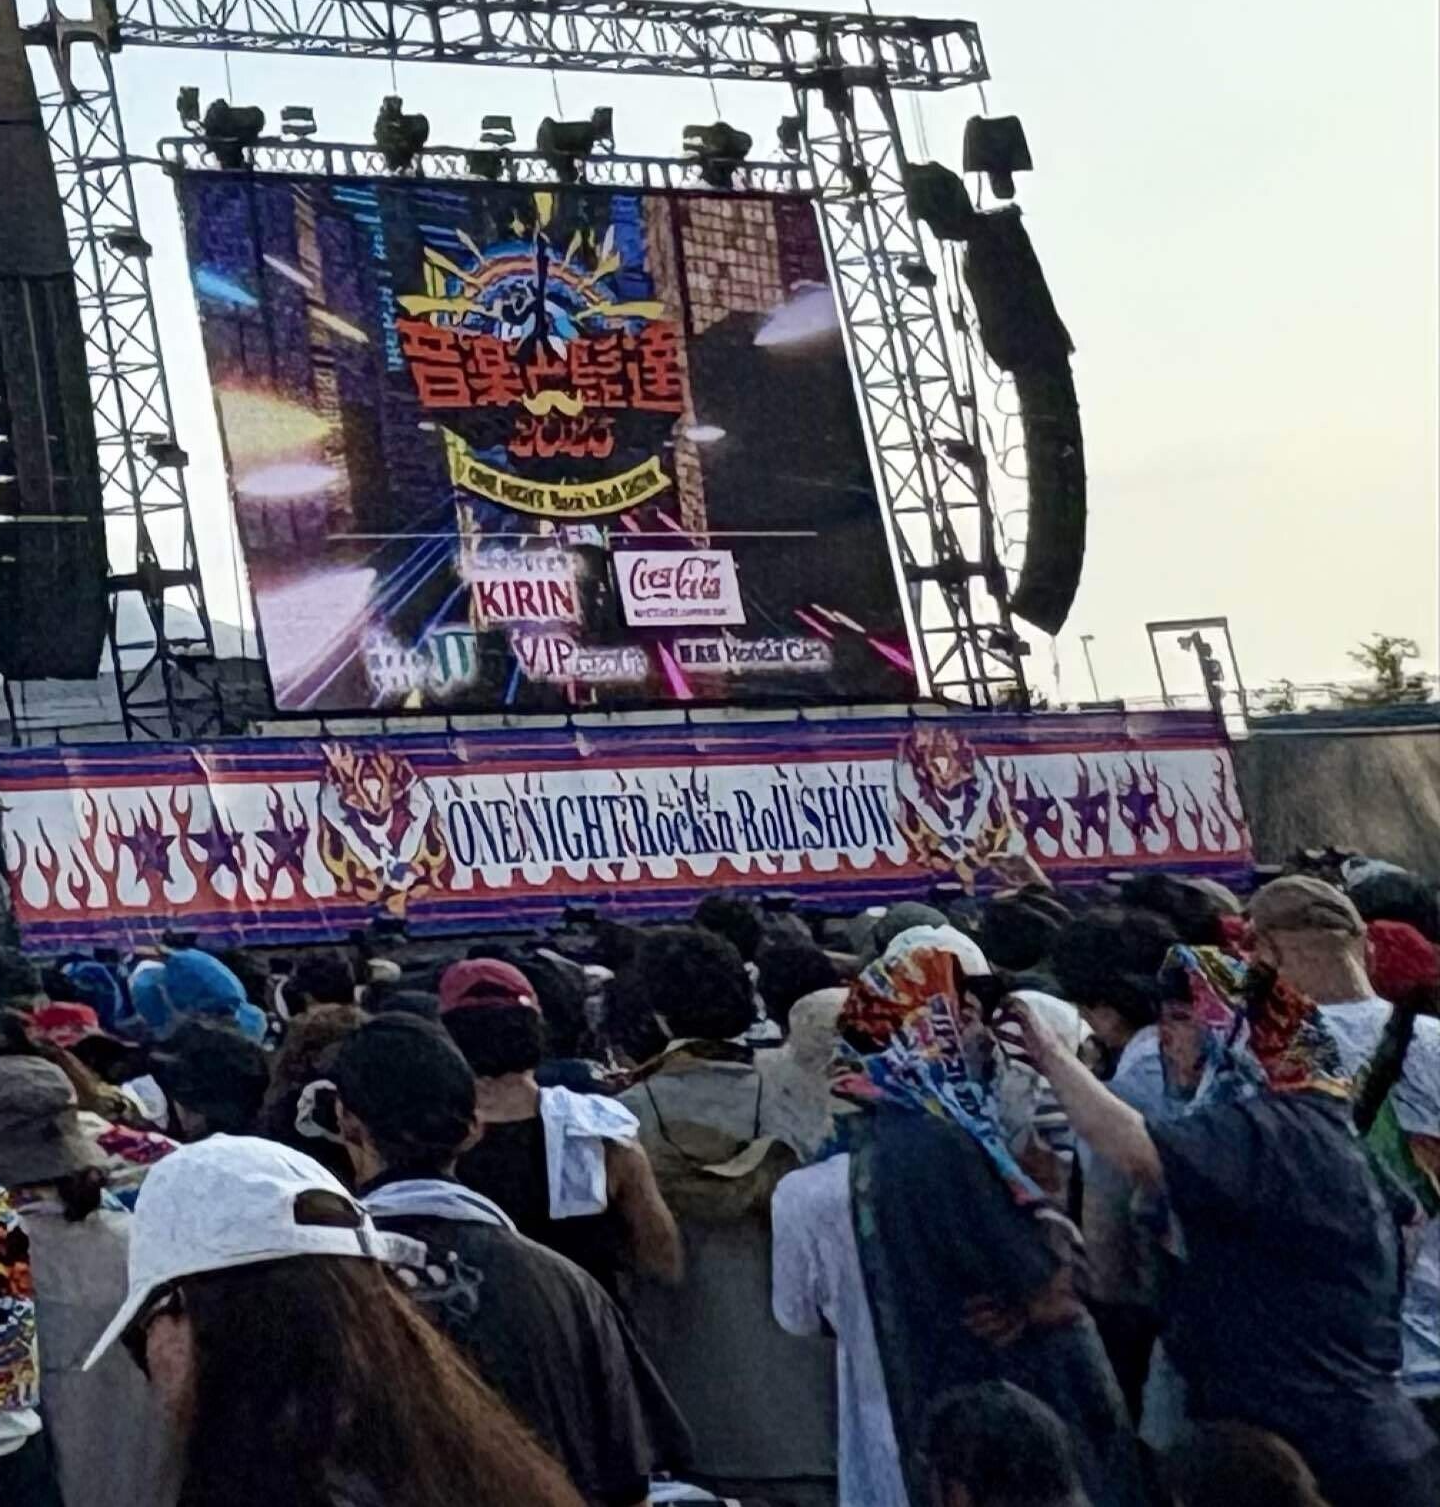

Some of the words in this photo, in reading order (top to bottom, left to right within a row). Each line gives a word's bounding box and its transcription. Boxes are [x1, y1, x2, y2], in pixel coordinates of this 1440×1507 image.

[480, 579, 576, 619] KIRIN
[447, 795, 522, 868] ONE
[523, 791, 627, 863] NIGHT
[734, 783, 799, 852] Roll
[799, 782, 896, 850] SHOW
